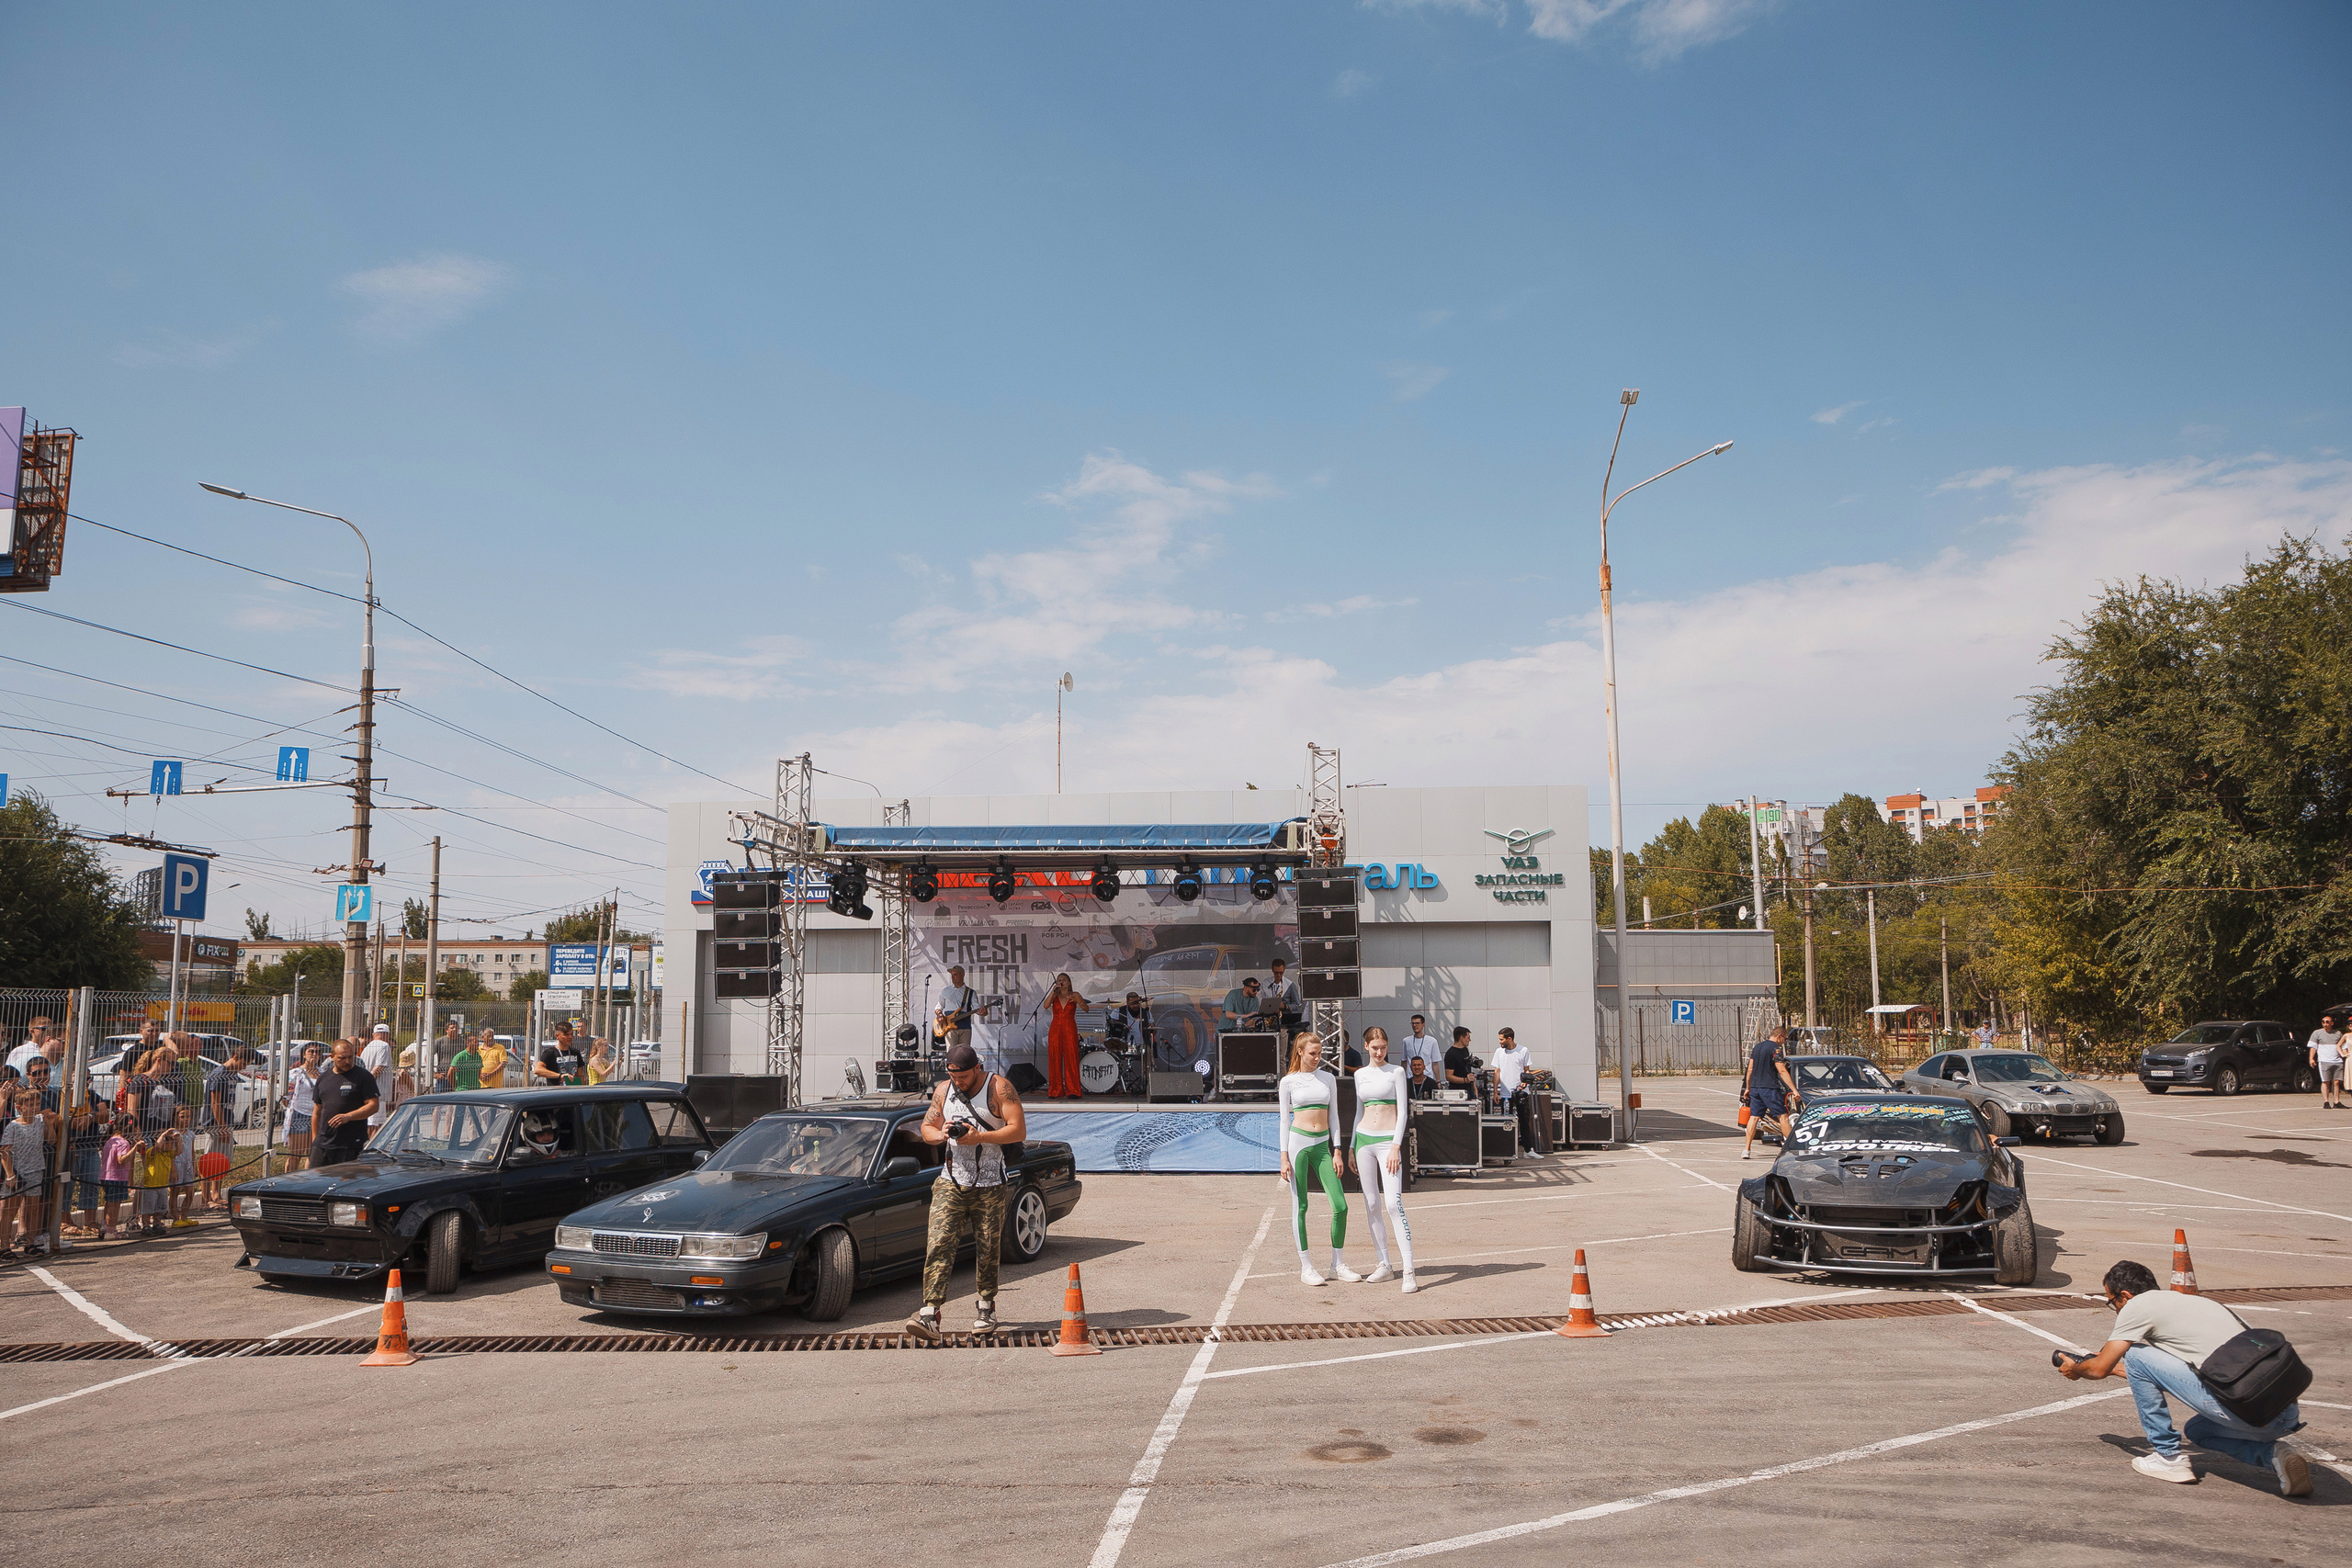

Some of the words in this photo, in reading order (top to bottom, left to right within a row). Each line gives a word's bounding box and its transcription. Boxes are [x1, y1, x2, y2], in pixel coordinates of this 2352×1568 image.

[1500, 856, 1539, 869] УАЗ
[174, 863, 199, 910] P
[1475, 874, 1564, 886] ЗАПАСНЫЕ
[1493, 890, 1545, 902] ЧАСТИ
[943, 933, 1028, 964] FRESH
[969, 964, 1021, 994] UTO
[1678, 1002, 1690, 1020] P
[945, 1104, 986, 1118] FLAWSS
[1882, 1106, 1945, 1115] MATSURI
[1794, 1121, 1829, 1144] 57
[1808, 1143, 1878, 1152] TOYO
